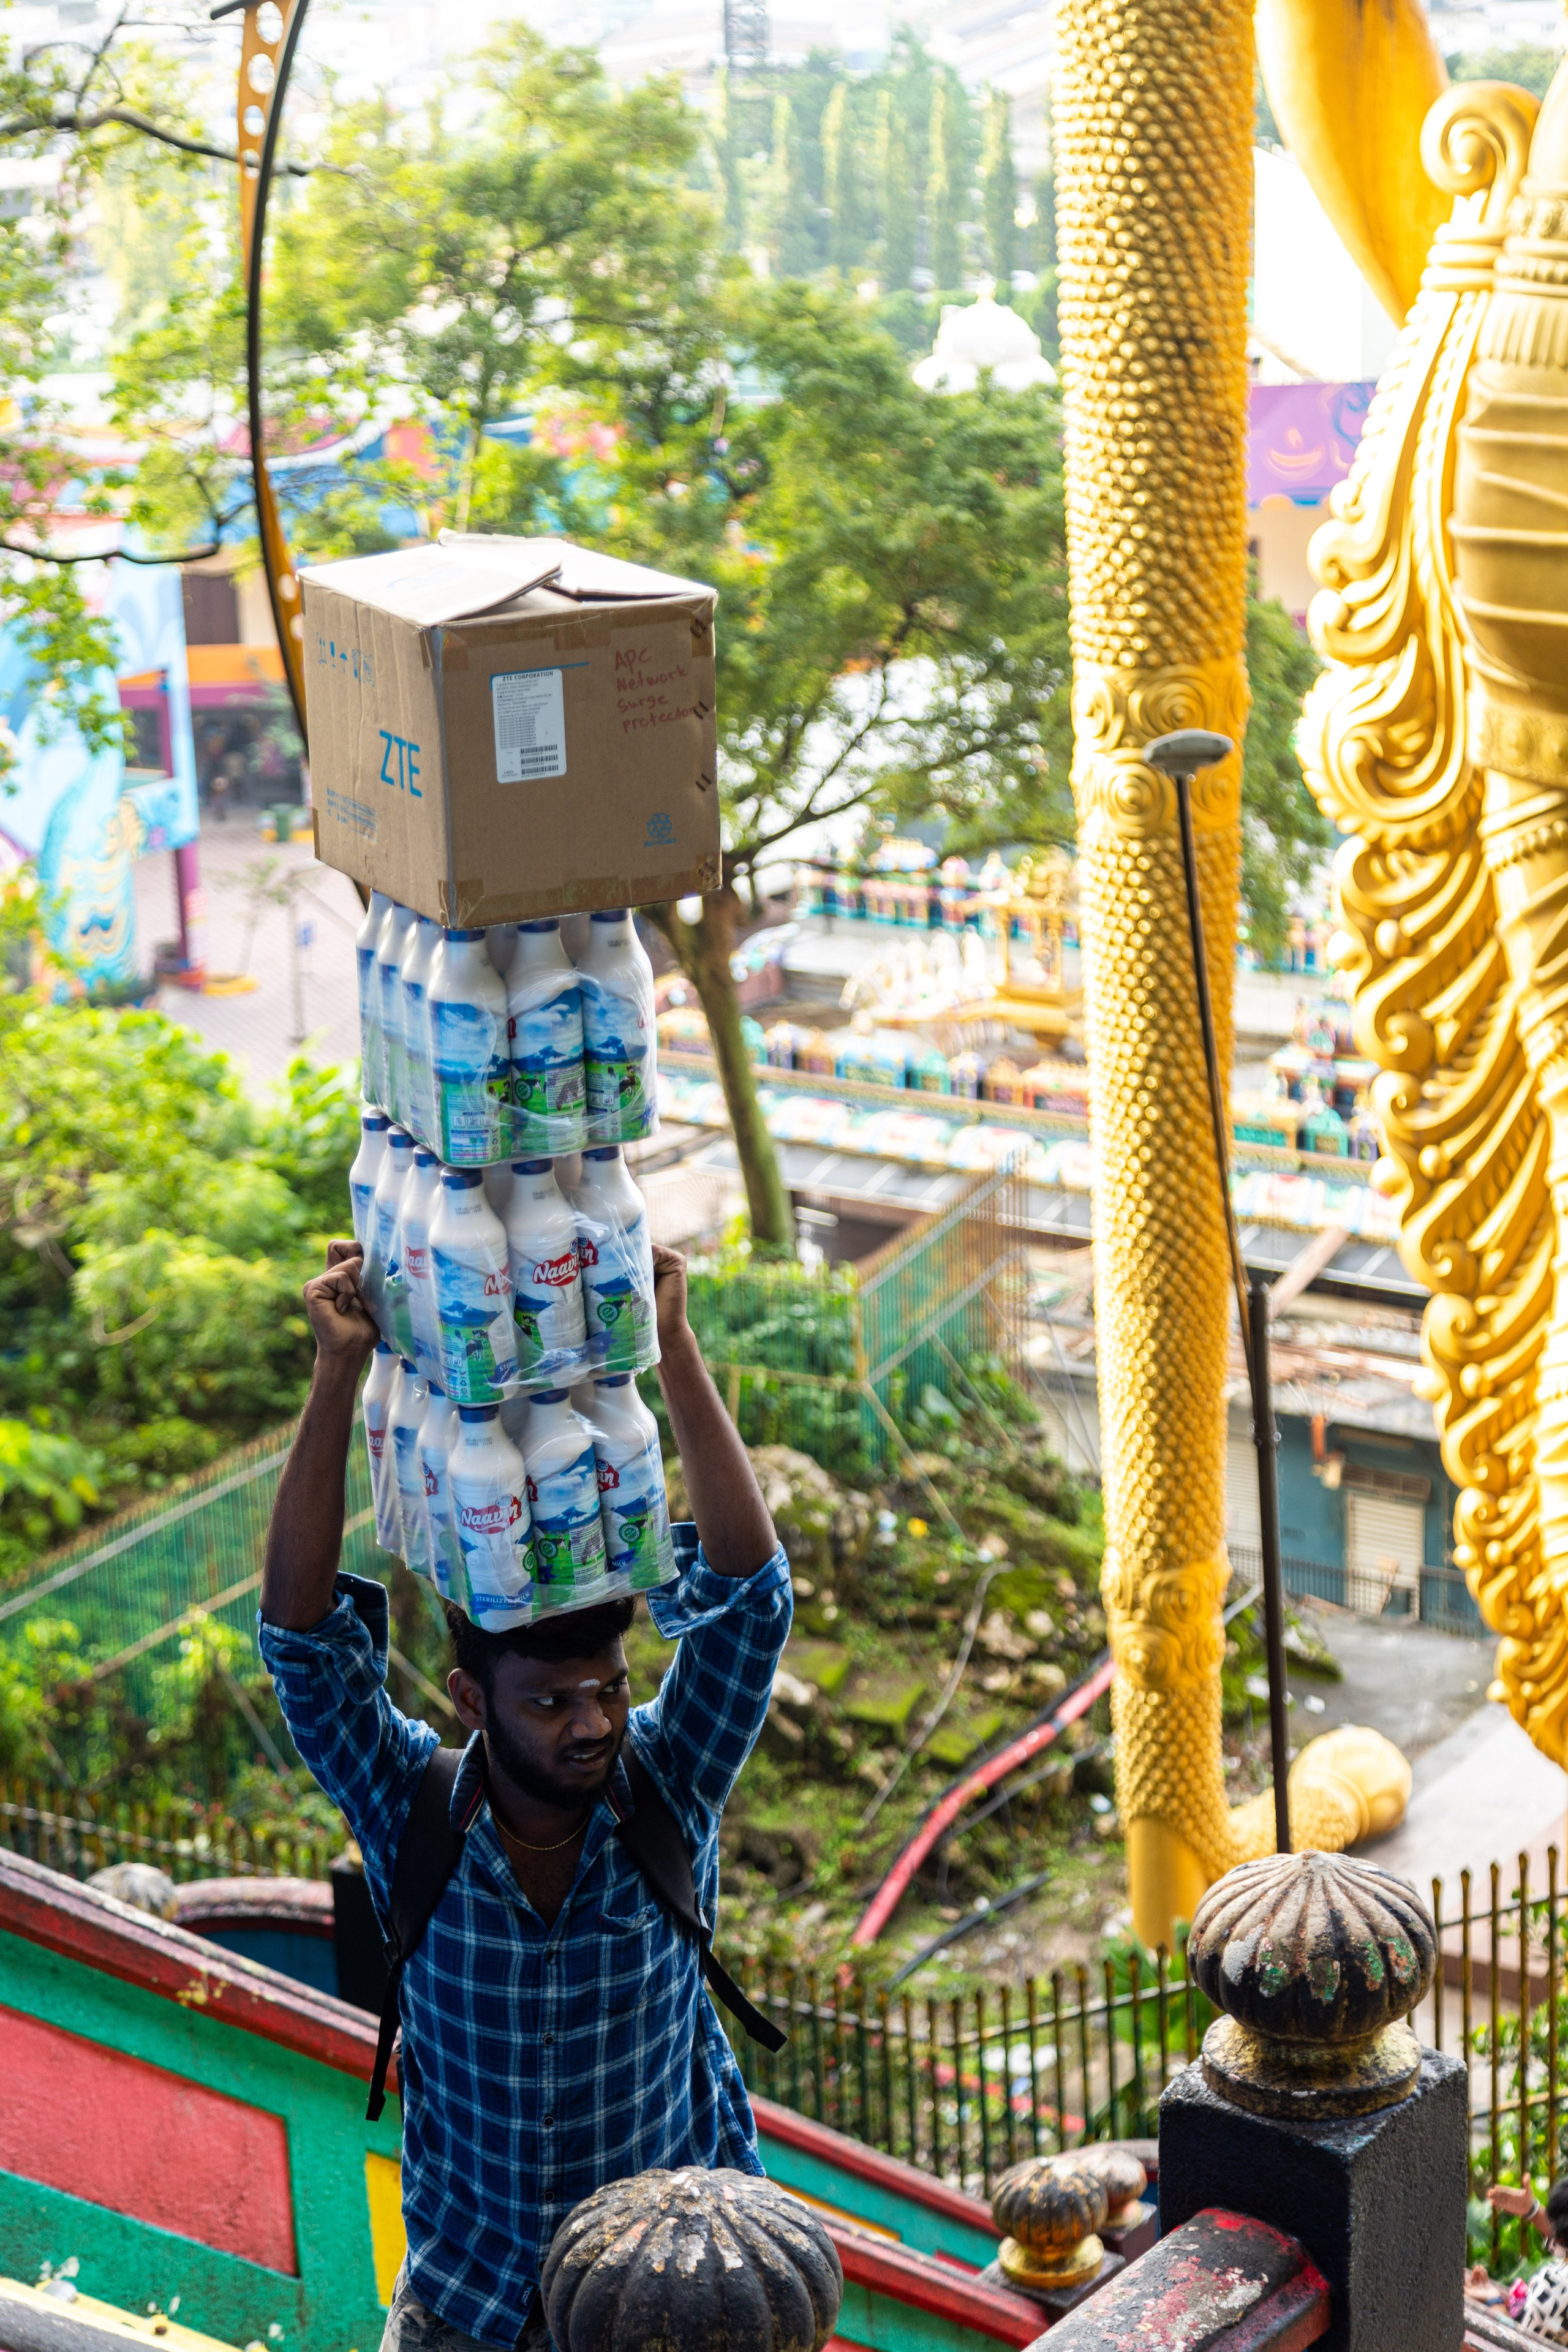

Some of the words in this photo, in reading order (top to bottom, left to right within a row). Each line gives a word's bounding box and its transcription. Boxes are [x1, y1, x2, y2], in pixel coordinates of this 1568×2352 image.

[615, 648, 652, 674] APC
[514, 671, 554, 680] CORPORATION
[616, 664, 688, 692] Network
[379, 729, 423, 798] ZTE
